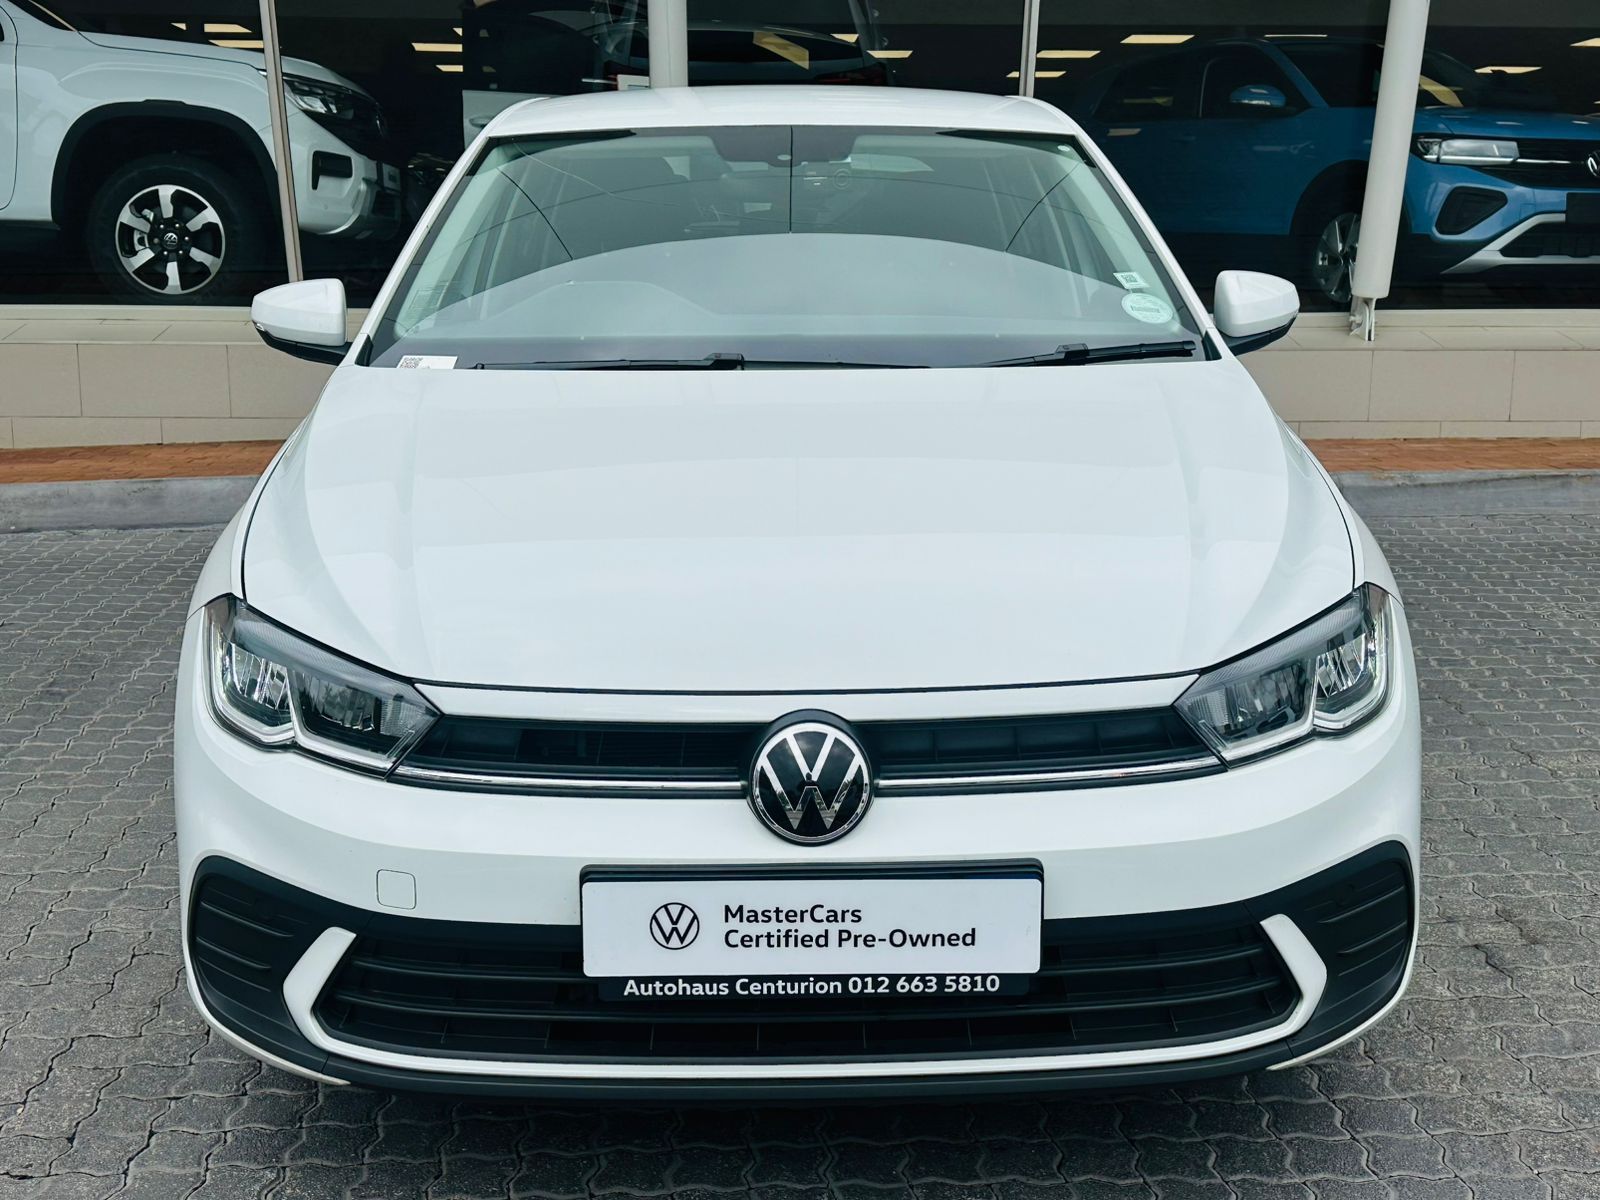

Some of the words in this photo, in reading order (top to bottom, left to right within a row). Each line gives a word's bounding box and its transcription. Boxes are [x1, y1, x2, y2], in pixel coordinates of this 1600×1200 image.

[754, 723, 869, 841] VW
[724, 903, 863, 924] MasterCars
[650, 902, 700, 950] VW
[724, 928, 829, 949] Certified
[837, 928, 976, 949] Pre-Owned
[623, 978, 729, 996] Autohaus
[735, 977, 842, 996] Centurion
[848, 976, 890, 995] 012
[896, 975, 938, 994] 663
[944, 974, 1000, 993] 5810
